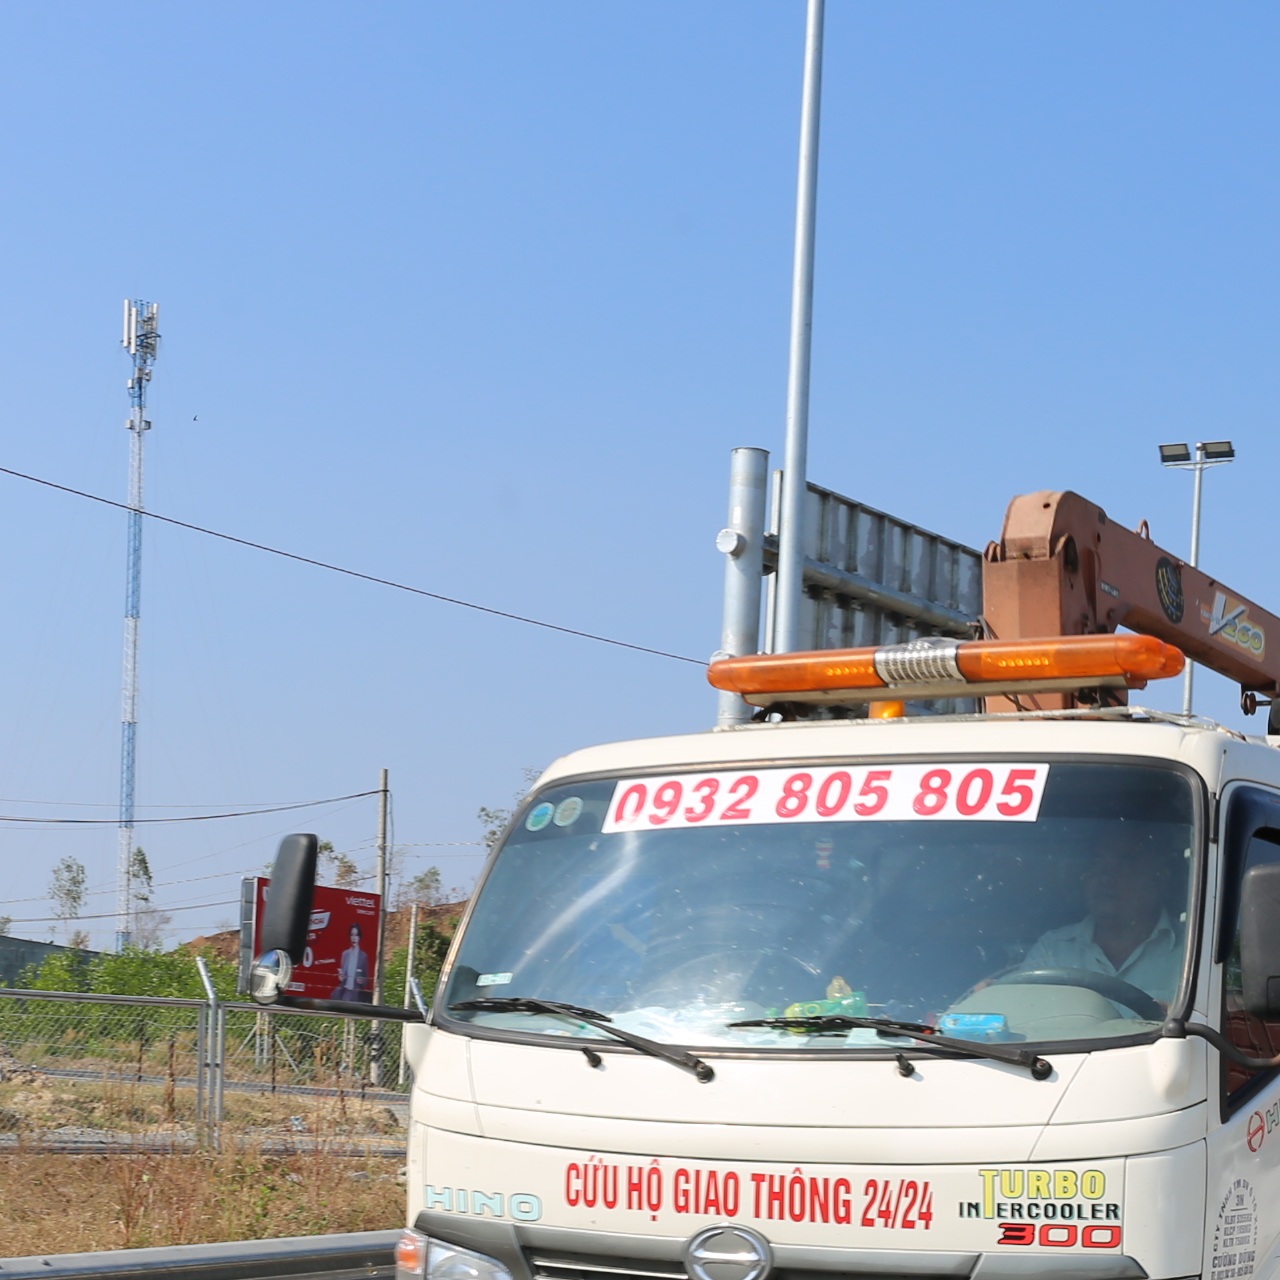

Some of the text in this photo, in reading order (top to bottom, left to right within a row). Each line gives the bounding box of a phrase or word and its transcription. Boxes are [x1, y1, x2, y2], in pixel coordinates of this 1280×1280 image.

[615, 768, 1036, 825] 0932 805 805
[423, 1184, 543, 1222] HINO
[564, 1154, 934, 1231] CỨU HỘ GIAO THÔNG 24/24
[978, 1169, 1106, 1219] TURBO
[996, 1222, 1122, 1249] 300
